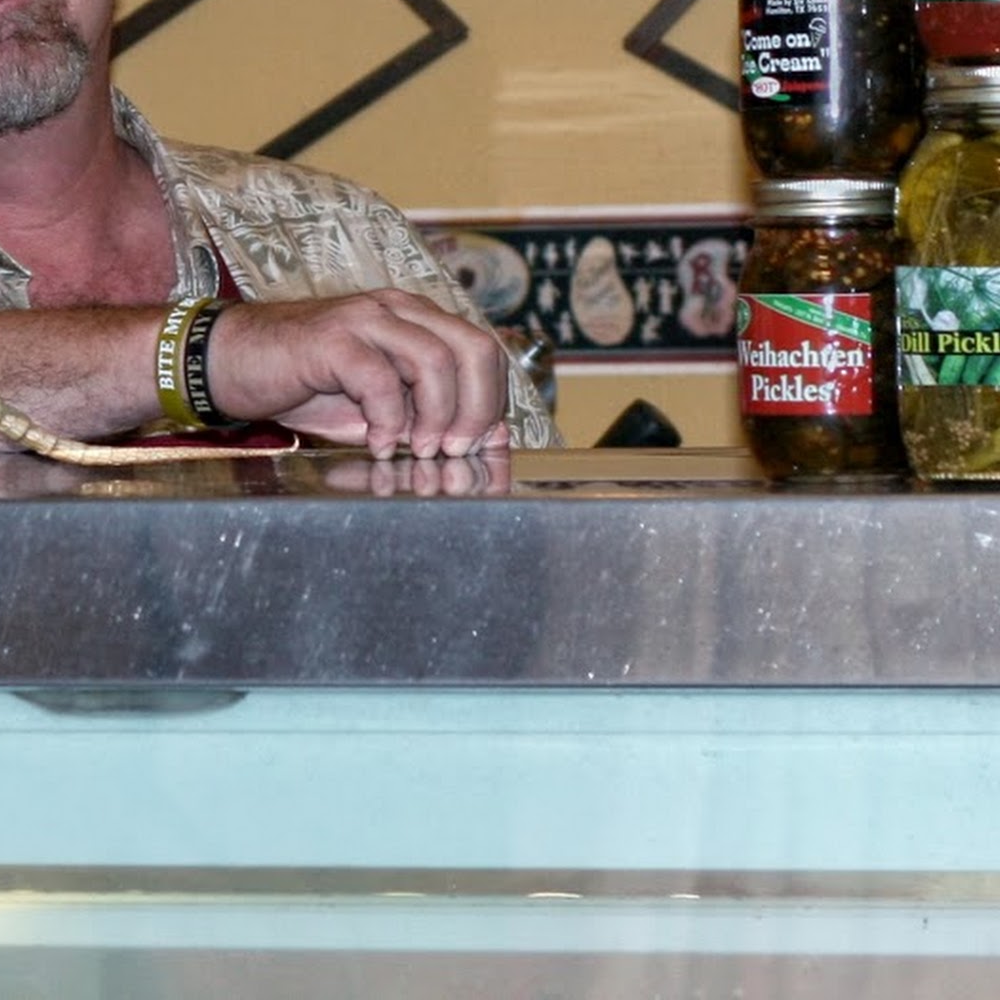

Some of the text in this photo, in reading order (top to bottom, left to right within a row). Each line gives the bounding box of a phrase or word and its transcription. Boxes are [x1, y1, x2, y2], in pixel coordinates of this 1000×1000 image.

[785, 32, 811, 48] on
[163, 307, 188, 335] MY
[901, 331, 930, 353] Dill
[158, 339, 175, 391] BITE
[187, 354, 212, 413] BITE
[751, 373, 836, 403] Pickles
